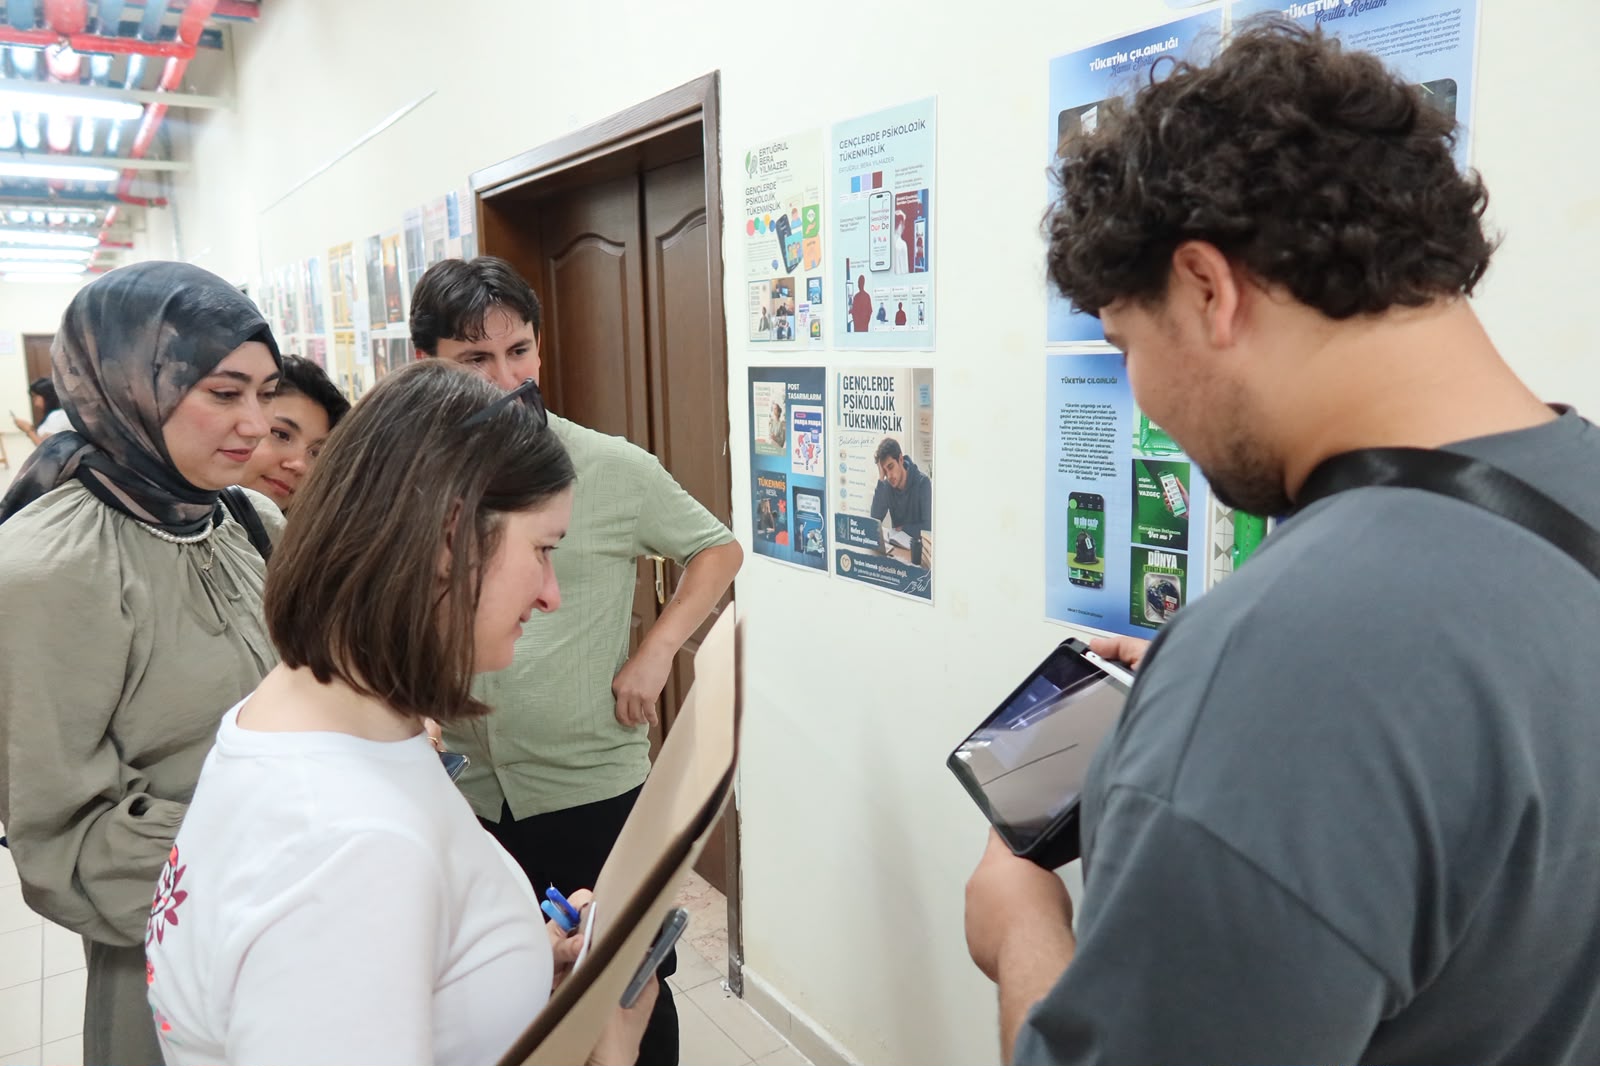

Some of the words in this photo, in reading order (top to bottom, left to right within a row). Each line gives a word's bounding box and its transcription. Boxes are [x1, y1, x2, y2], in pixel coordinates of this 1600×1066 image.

[1348, 0, 1387, 17] Reklam
[1089, 52, 1128, 72] TÜKETİM
[1130, 36, 1178, 62] ÇILGINLIĞI
[840, 132, 880, 149] GENÇLERDE
[882, 118, 926, 139] PSİKOLOJİK
[759, 155, 774, 166] BERA
[840, 142, 885, 162] TÜKENMİŞLİK
[745, 182, 777, 196] GENÇLERDE
[745, 192, 776, 206] PSİKOLOJİK
[746, 201, 781, 216] TÜKENMİŞLİK
[843, 376, 894, 393] GENÇLERDE
[1061, 376, 1086, 384] TÜKETİM
[843, 392, 895, 411] PSİKOLOJİK
[843, 410, 902, 434] TÜKENMİŞLİK
[758, 476, 786, 492] TÜKENMİŞ
[1138, 490, 1160, 499] VAZGEÇ
[1148, 551, 1177, 569] DÜNYA
